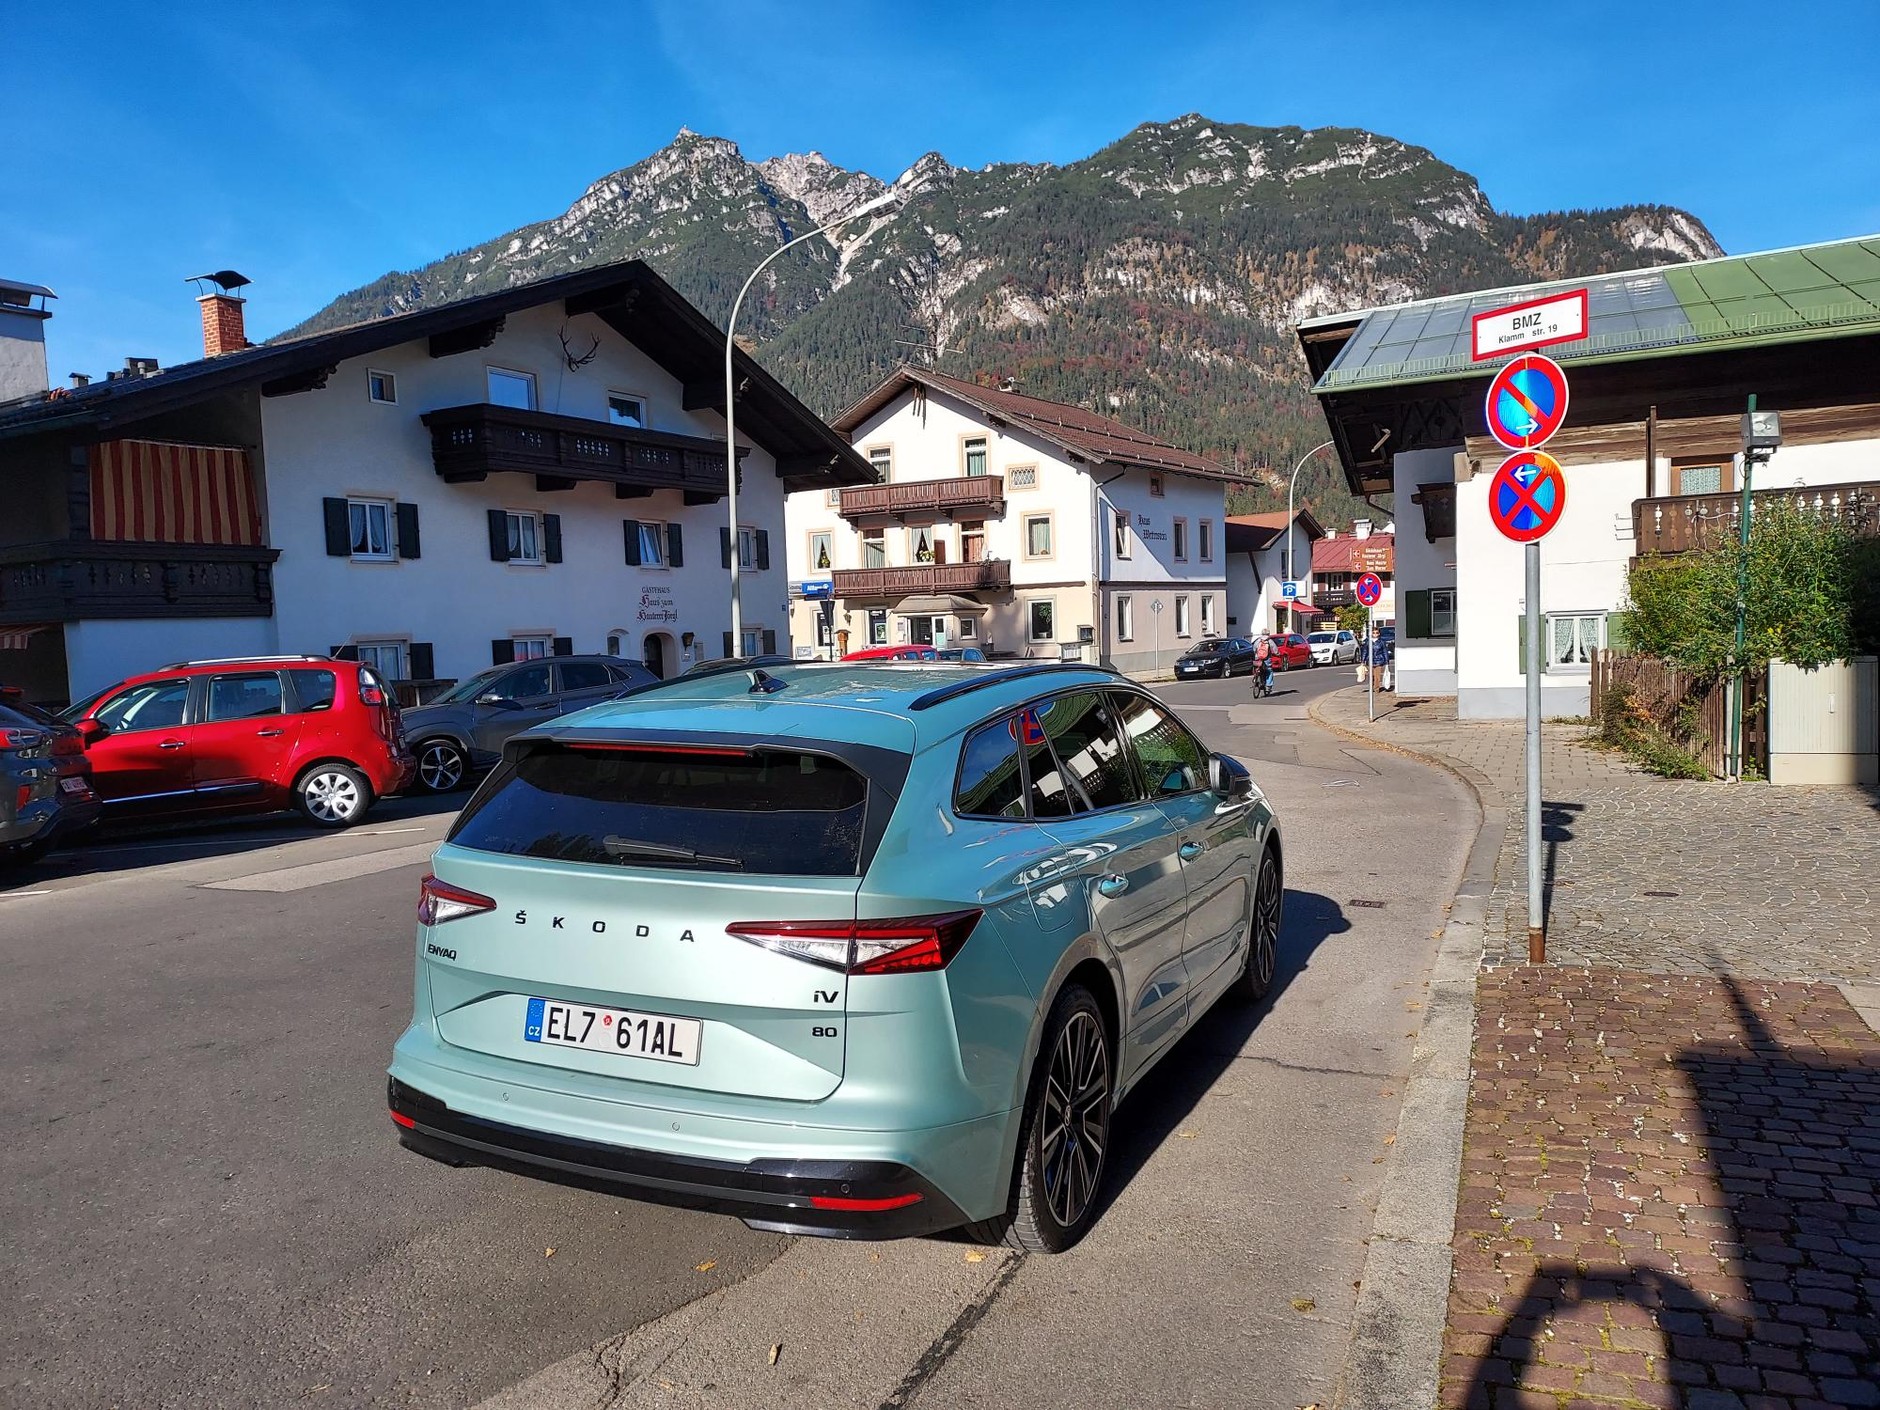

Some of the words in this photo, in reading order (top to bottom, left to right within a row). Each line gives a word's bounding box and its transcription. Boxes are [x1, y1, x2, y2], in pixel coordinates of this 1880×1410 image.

[1512, 312, 1542, 330] BMZ
[1498, 332, 1525, 344] Klamm
[1532, 328, 1546, 337] str.
[1548, 323, 1558, 334] 19
[515, 910, 695, 943] ŠKODA
[428, 943, 457, 961] ENYAQ
[813, 990, 840, 1004] iV
[527, 1025, 541, 1037] CZ
[547, 1006, 596, 1043] EL7
[616, 1017, 683, 1058] 61AL
[812, 1026, 838, 1038] 80
